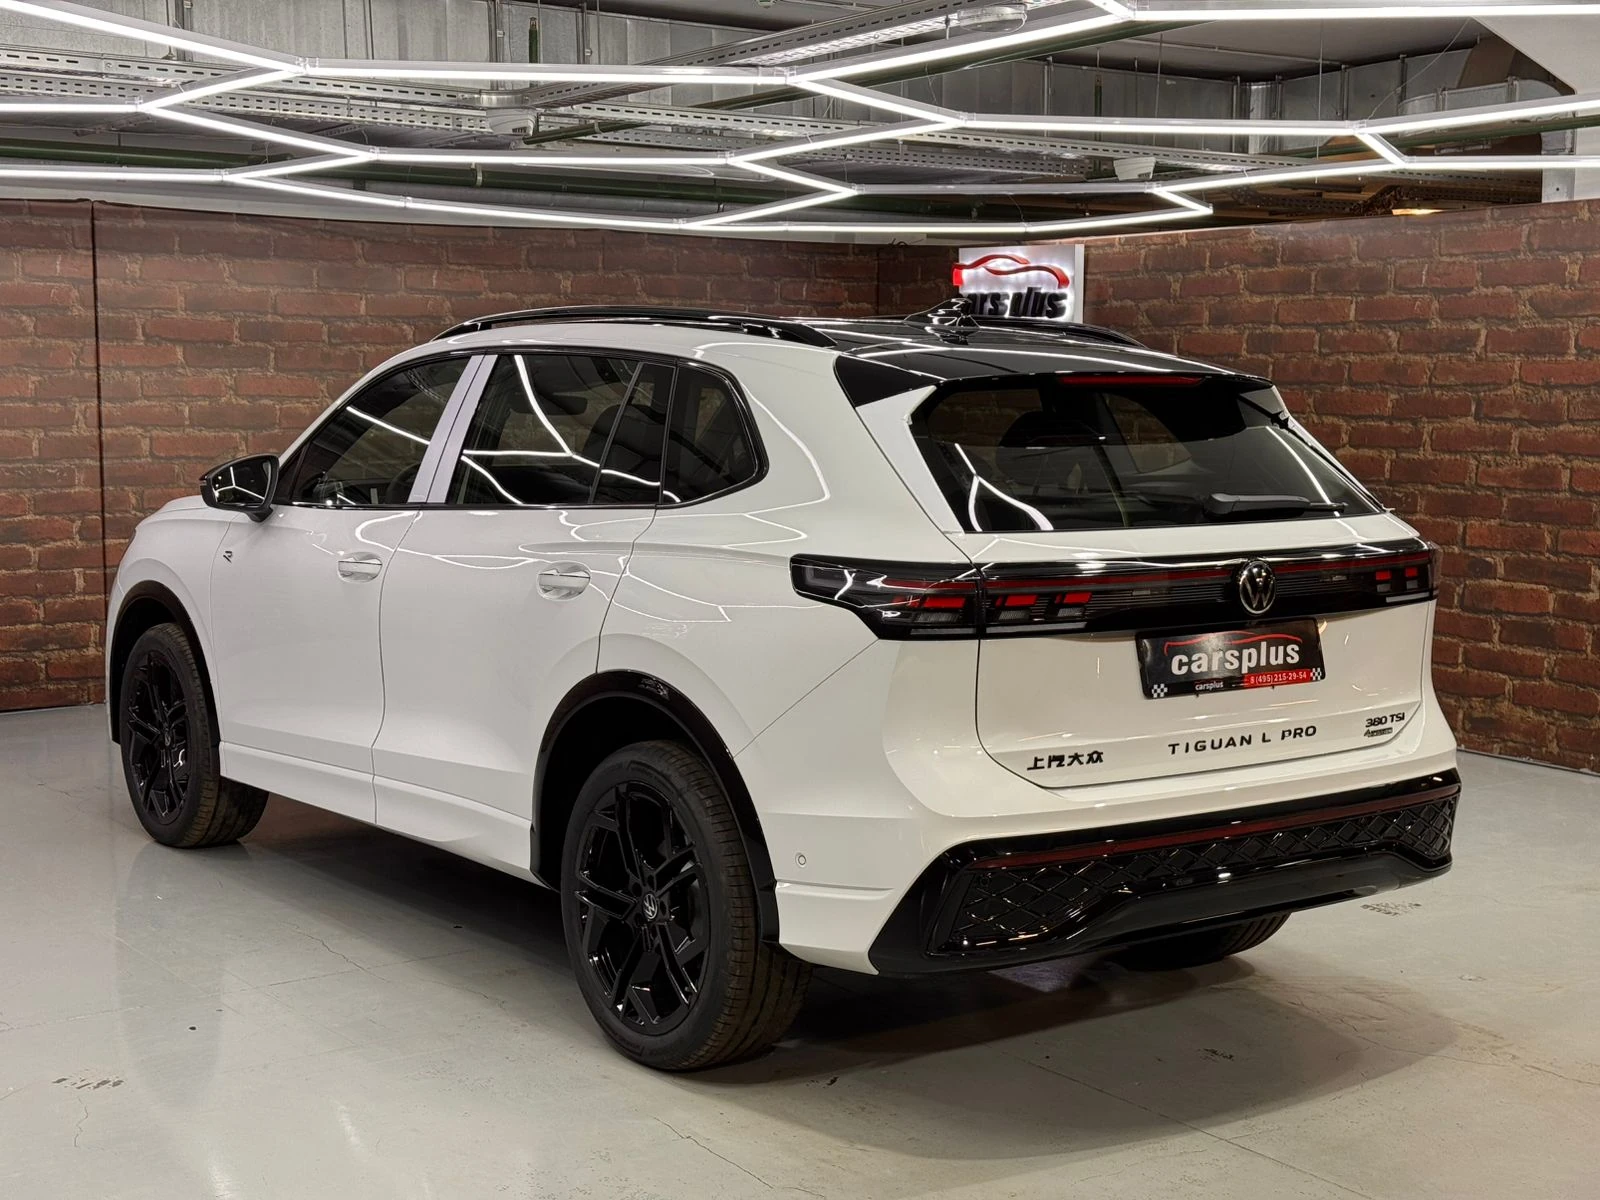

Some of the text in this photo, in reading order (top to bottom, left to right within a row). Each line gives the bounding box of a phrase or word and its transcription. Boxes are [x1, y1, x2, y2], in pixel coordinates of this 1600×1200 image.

[961, 291, 1009, 316] ars
[1171, 641, 1300, 675] carsplus
[1195, 680, 1224, 691] carsplus
[1250, 672, 1307, 685] 8 (495) 215-29-54
[1365, 712, 1405, 728] 380 TSI
[1168, 725, 1317, 755] TIGUAN L PRO
[1026, 750, 1104, 771] 上汽大众
